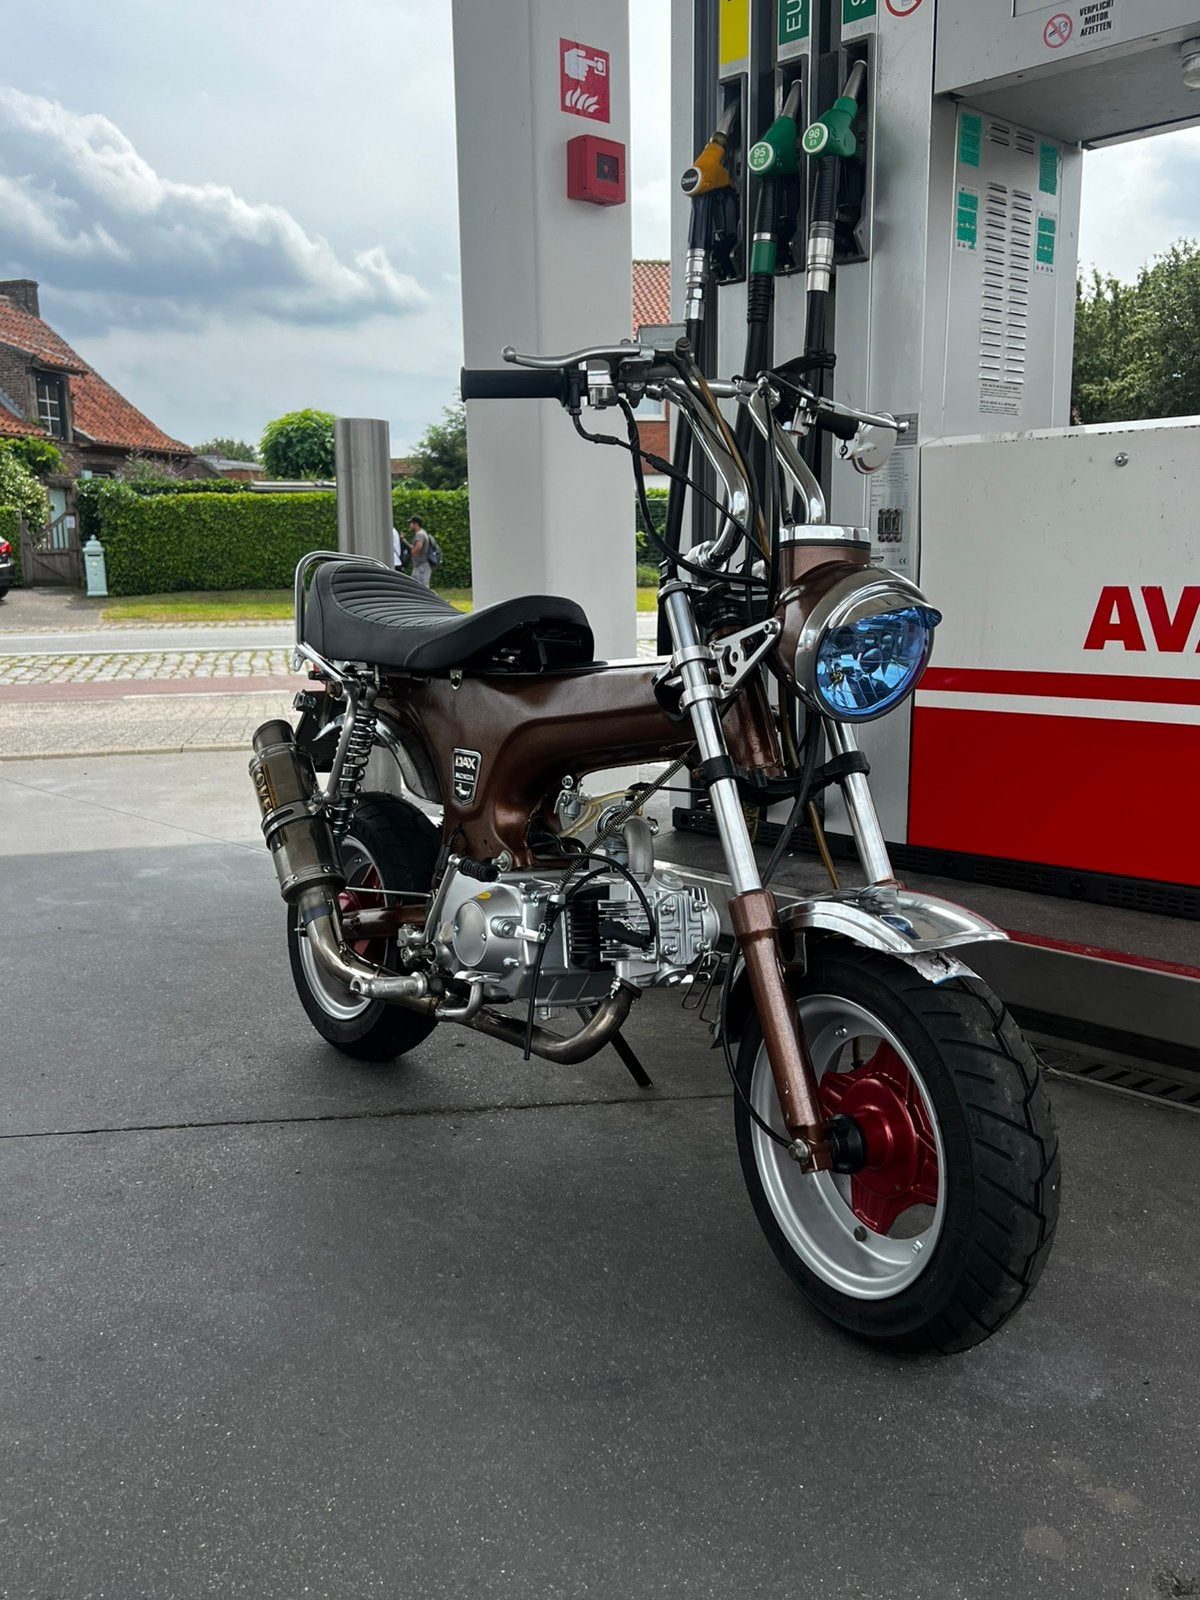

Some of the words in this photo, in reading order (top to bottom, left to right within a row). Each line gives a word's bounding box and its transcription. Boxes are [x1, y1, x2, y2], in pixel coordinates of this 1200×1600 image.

[1080, 0, 1114, 16] VERPLICHT
[1084, 11, 1109, 25] MOTOR
[1080, 21, 1112, 37] AFZETTEN
[808, 128, 820, 139] 98
[753, 147, 766, 158] 95
[1083, 586, 1200, 653] AV
[455, 755, 476, 770] DAX
[255, 772, 274, 816] OVE
